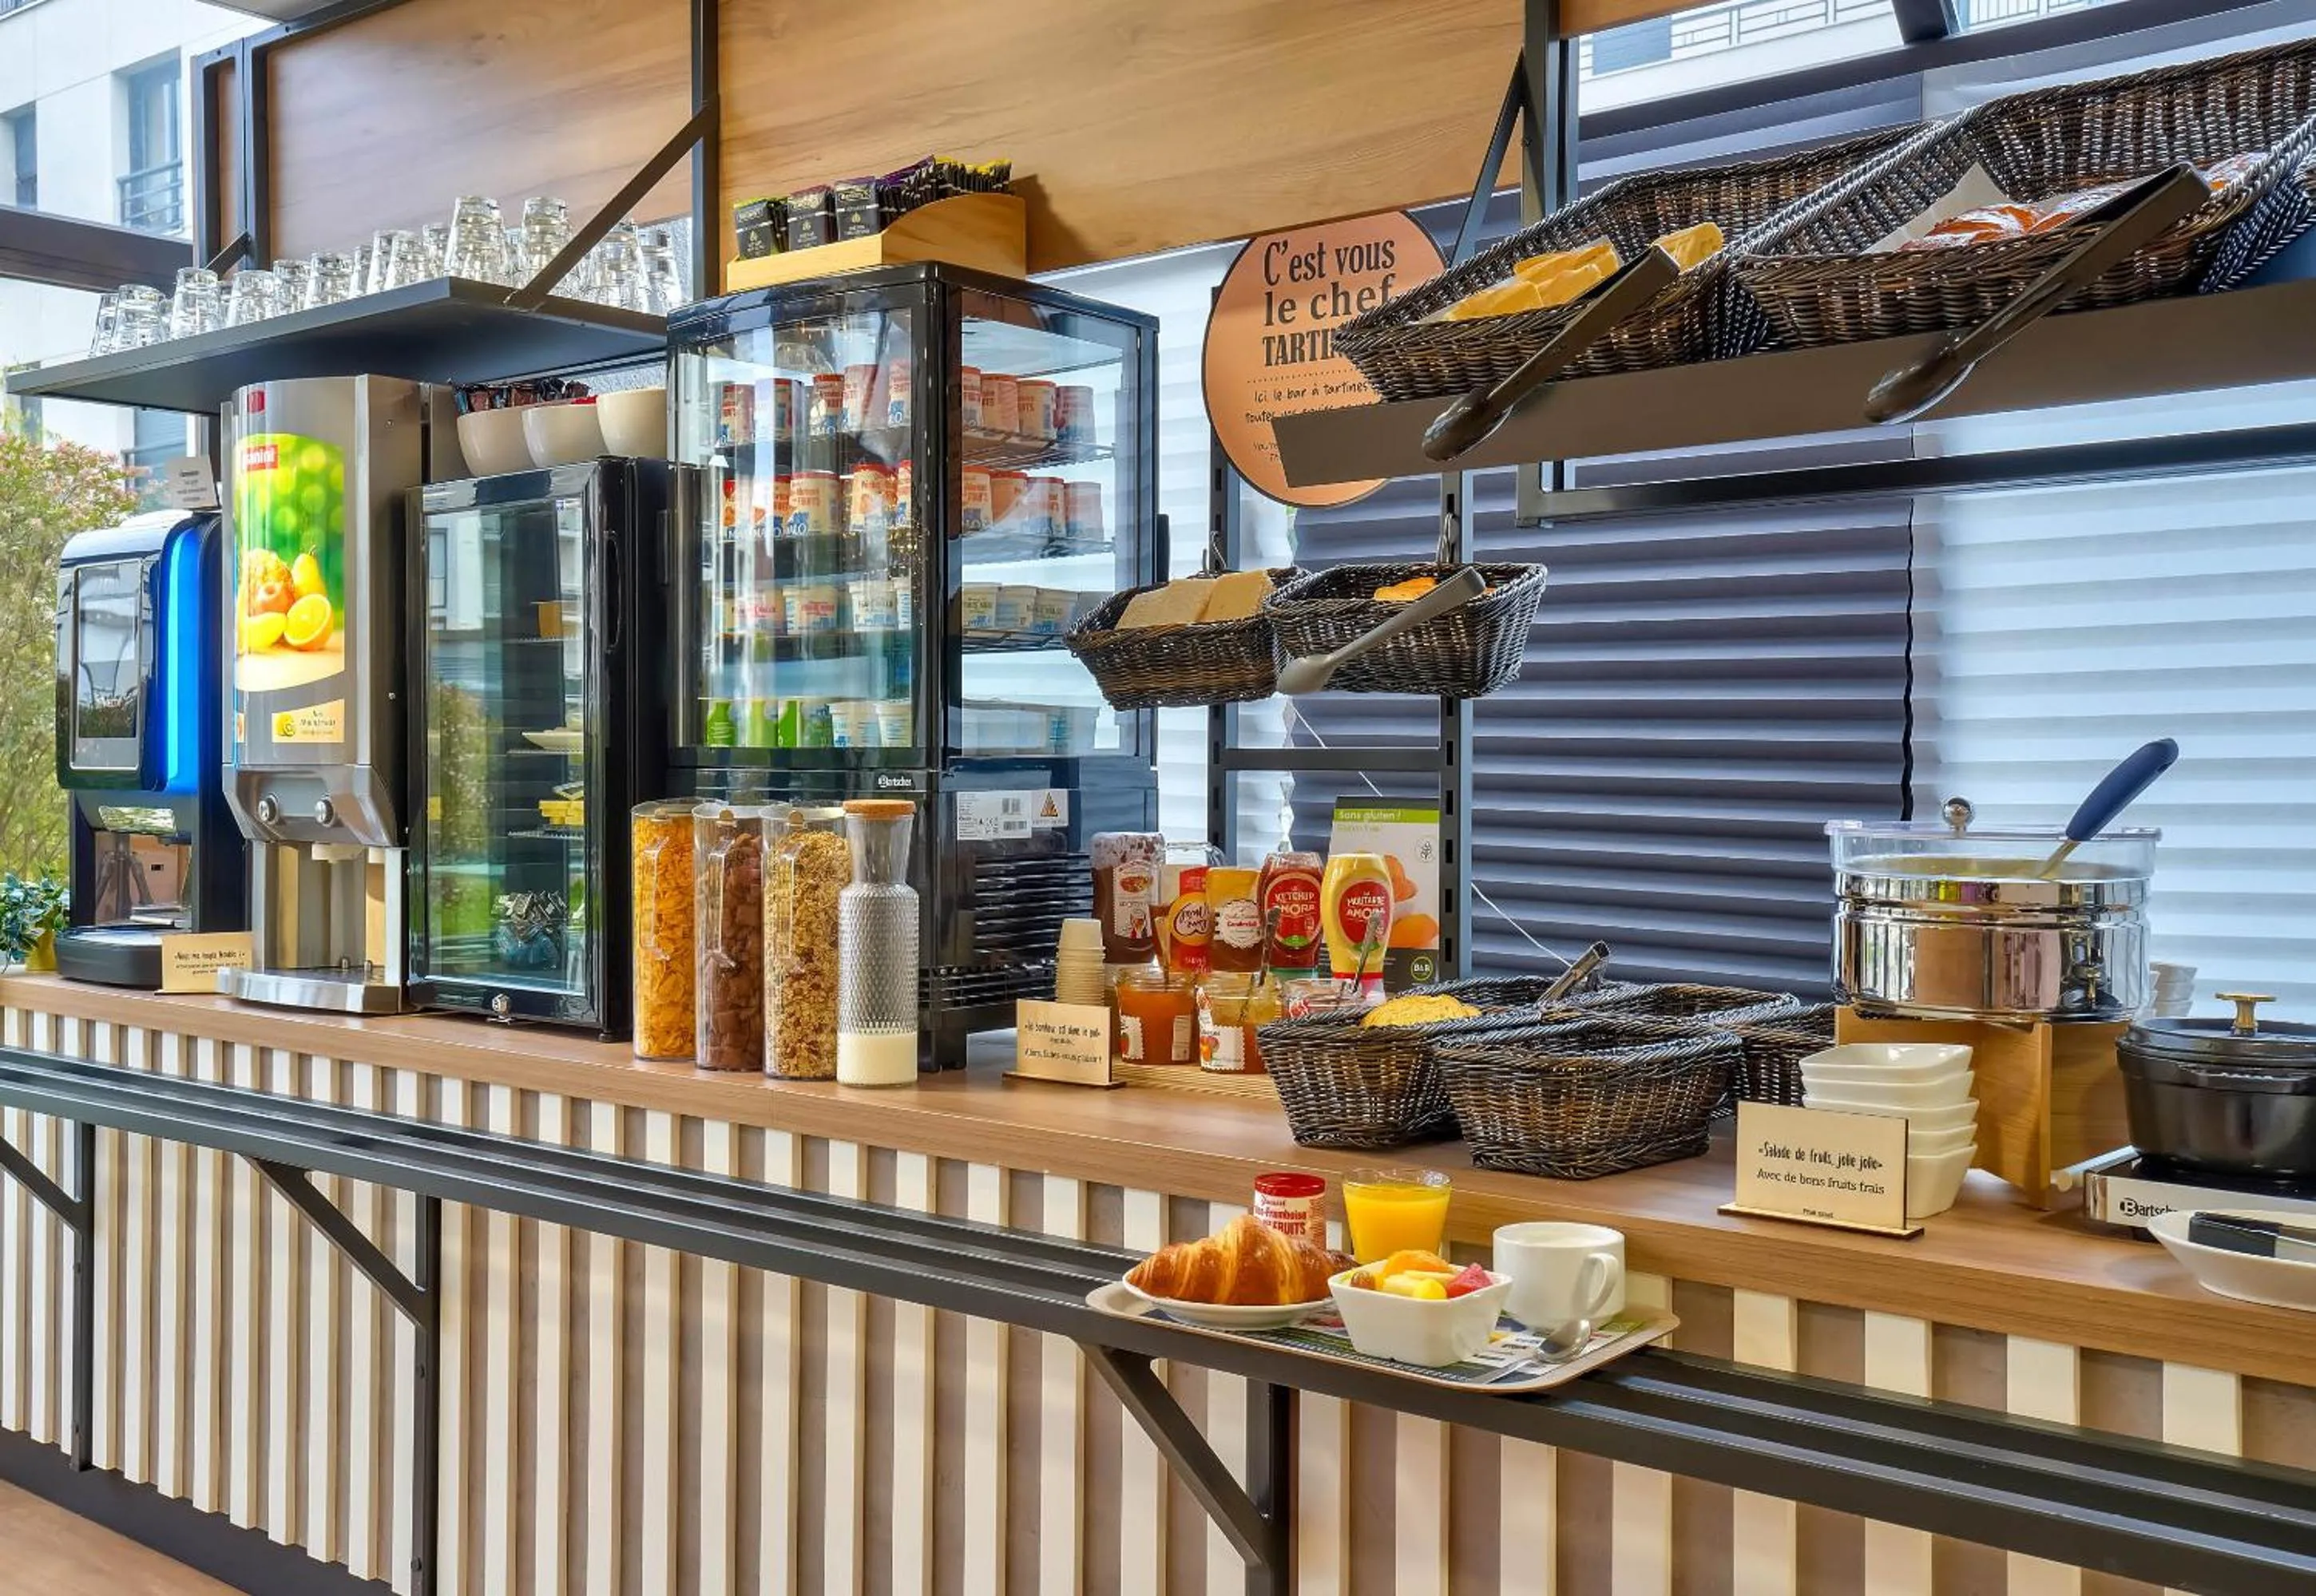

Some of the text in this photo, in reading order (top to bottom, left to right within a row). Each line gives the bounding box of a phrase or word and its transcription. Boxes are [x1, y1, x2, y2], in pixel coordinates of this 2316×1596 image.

[1264, 240, 1395, 285] C'est vous
[1265, 273, 1396, 326] le chef
[1255, 391, 1267, 402] Ici
[1287, 388, 1307, 399] bar
[1323, 381, 1368, 394] tartines
[1275, 891, 1315, 903] KETCHUP
[1278, 904, 1315, 915] MORA
[1795, 1147, 1805, 1161] de
[1837, 1152, 1856, 1169] jolie
[1757, 1168, 1885, 1194] Avec de bons fruits frais
